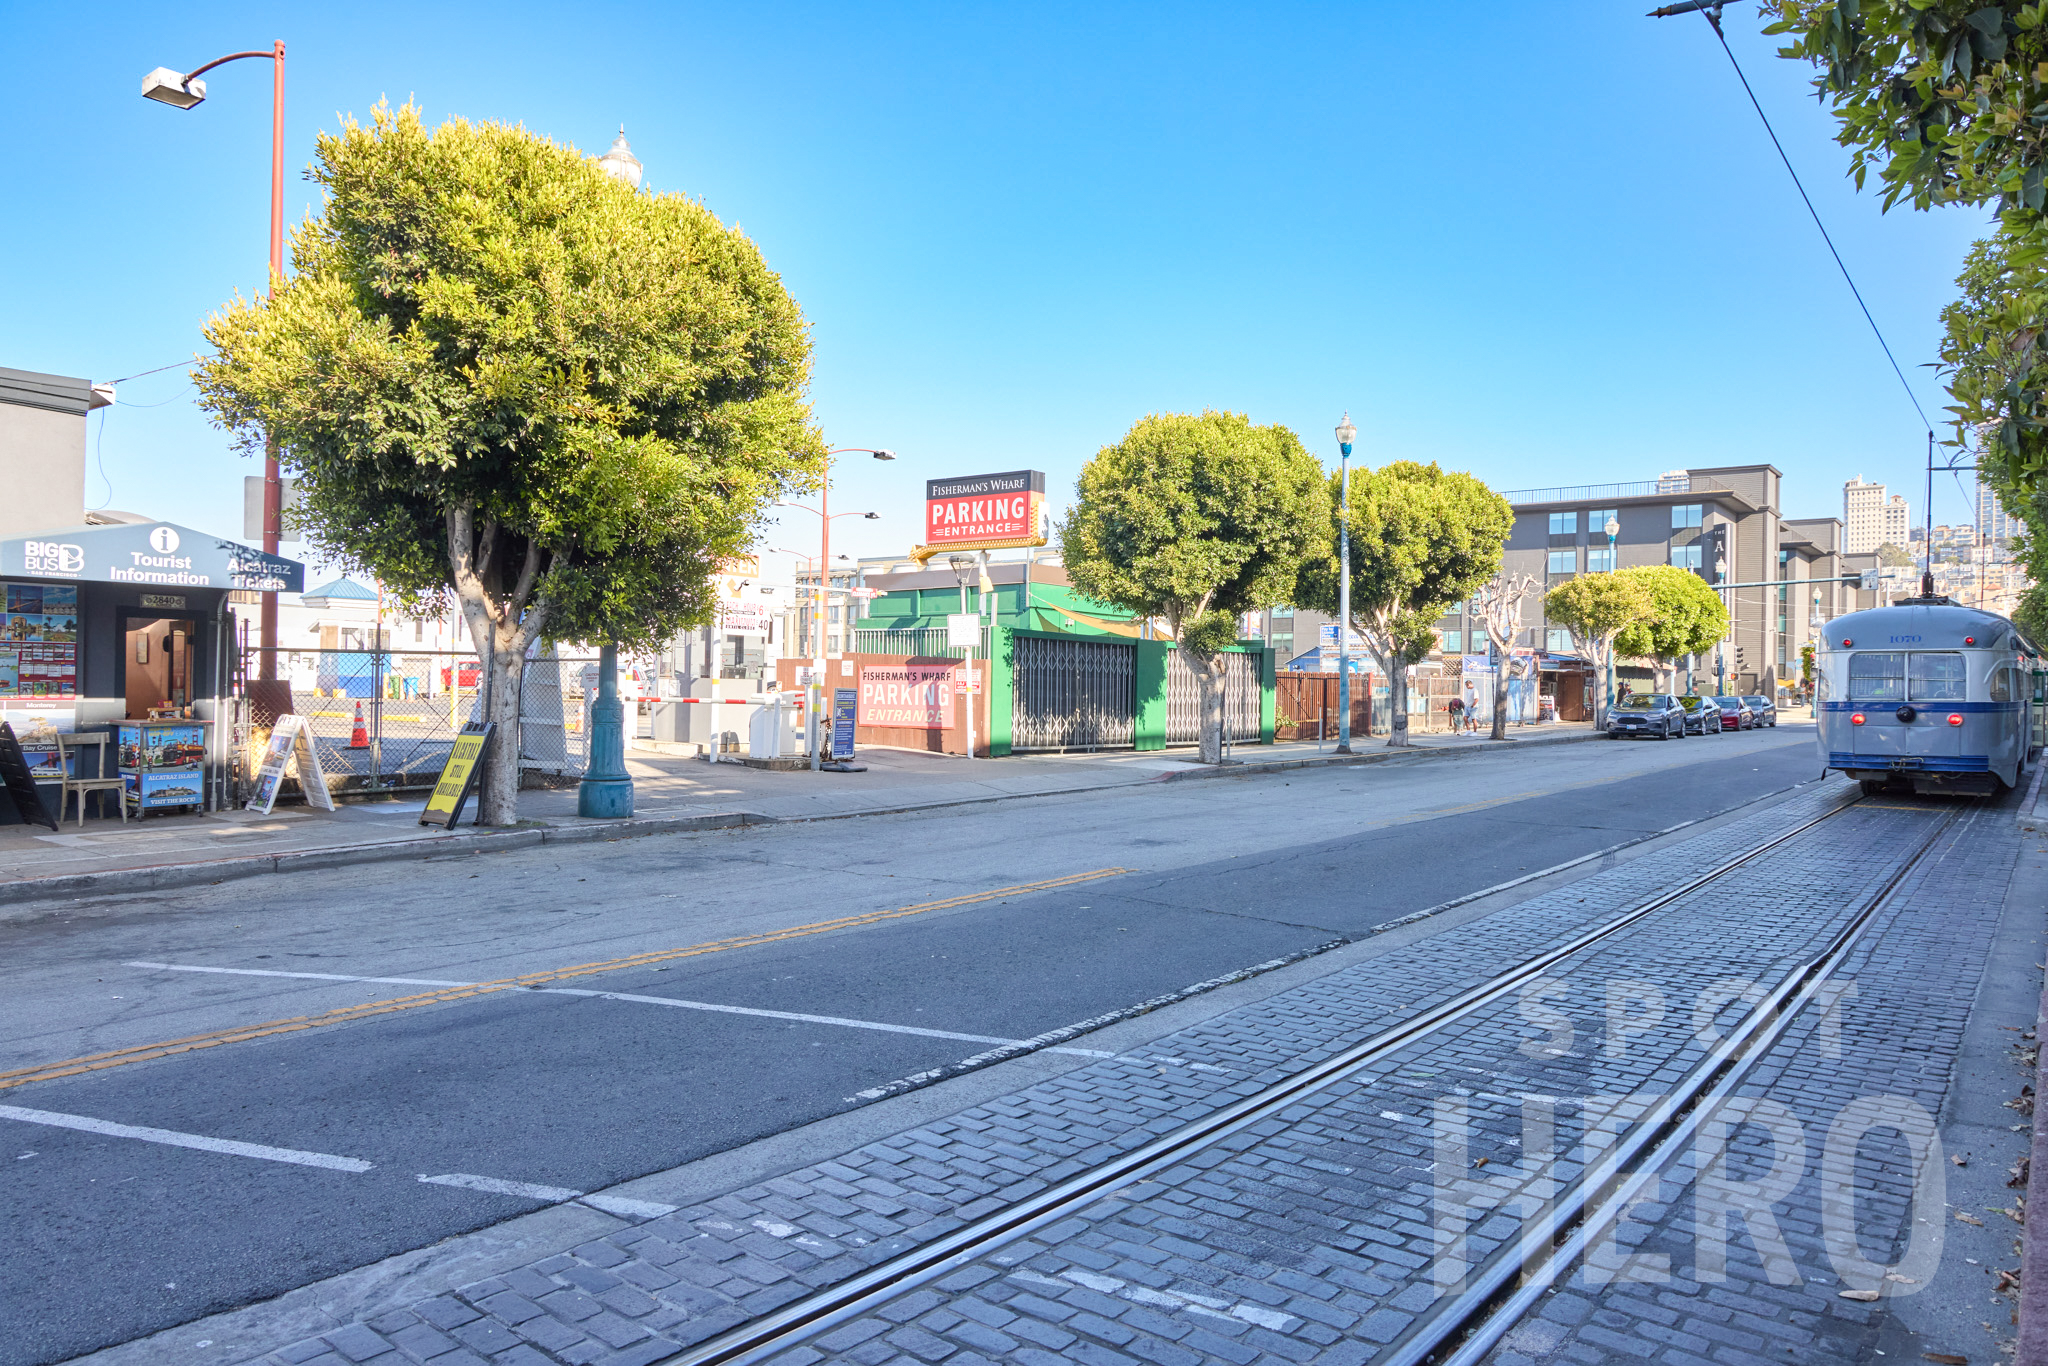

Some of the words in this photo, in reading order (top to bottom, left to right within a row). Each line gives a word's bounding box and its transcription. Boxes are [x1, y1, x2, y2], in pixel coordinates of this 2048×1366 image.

[932, 482, 989, 496] FISHERMAN'S
[990, 479, 1025, 490] WHARF
[932, 497, 1025, 525] PARKING
[944, 522, 1011, 537] ENTRANCE
[25, 541, 59, 557] BIG
[25, 556, 59, 571] BUS
[131, 552, 191, 569] Tourist
[227, 558, 291, 575] Alcatraz
[110, 566, 209, 586] Information
[232, 574, 287, 590] Tickets
[152, 595, 175, 605] 2840
[1890, 635, 1921, 643] 1070
[863, 671, 917, 681] FISHERMAN'S
[921, 672, 951, 681] WHARF
[863, 683, 950, 706] PARKING
[866, 708, 945, 723] ENTRANCE
[452, 742, 481, 760] ALCATRAZ
[435, 782, 464, 797] AVAILABLE
